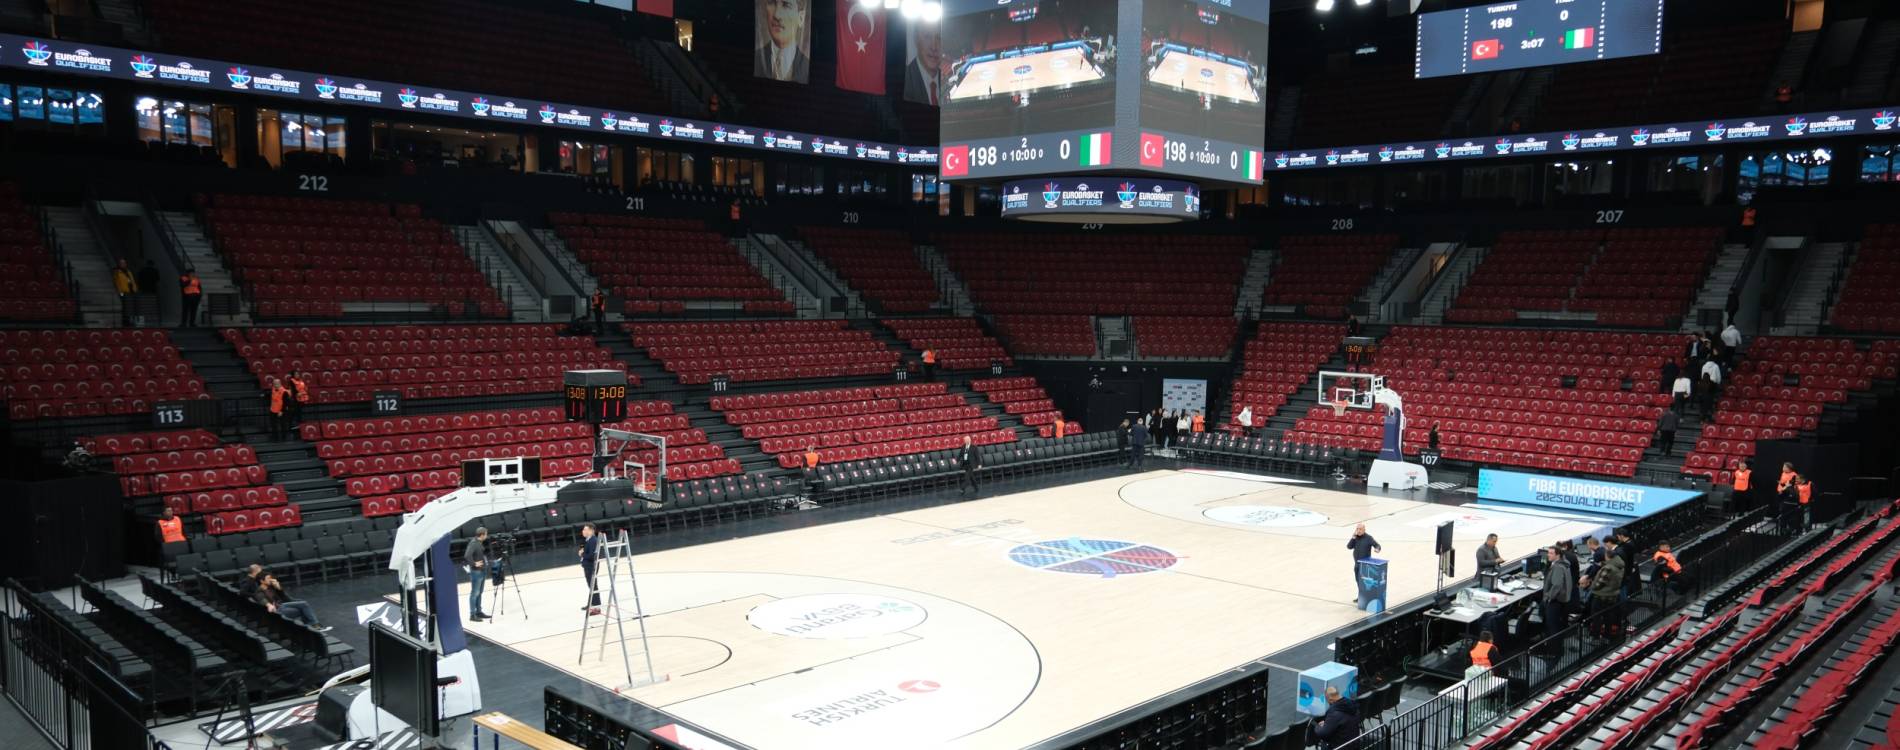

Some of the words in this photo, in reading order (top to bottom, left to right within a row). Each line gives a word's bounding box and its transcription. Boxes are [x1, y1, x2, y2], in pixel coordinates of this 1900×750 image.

[1560, 10, 1569, 21] 0
[1490, 18, 1513, 30] 198
[1521, 38, 1545, 49] 3:07
[55, 52, 112, 66] EUROBASKET
[160, 65, 211, 78] EUROBASKET
[1022, 138, 1027, 148] 2
[1204, 141, 1209, 151] 2
[1002, 152, 1007, 161] 0
[1010, 148, 1036, 162] 10:00
[1038, 149, 1043, 158] 0
[1060, 140, 1070, 160] 0
[1164, 140, 1186, 162] 198
[968, 146, 997, 167] 198
[1196, 152, 1215, 164] 10:00
[1230, 151, 1237, 170] 0
[300, 175, 328, 191] 212
[1062, 190, 1104, 200] EUROBASKET
[626, 197, 644, 210] 211
[843, 212, 859, 223] 210
[1596, 210, 1624, 224] 207
[1332, 218, 1353, 230] 208
[896, 372, 907, 380] 111
[714, 382, 727, 391] 111
[594, 387, 625, 399] 13:08
[376, 400, 398, 411] 112
[158, 410, 184, 424] 113
[1420, 455, 1438, 466] 107
[1528, 478, 1556, 494] FIBA
[1559, 480, 1644, 503] EUROBASKET
[791, 688, 888, 721] AIRLINES
[809, 695, 907, 727] TURKISH
